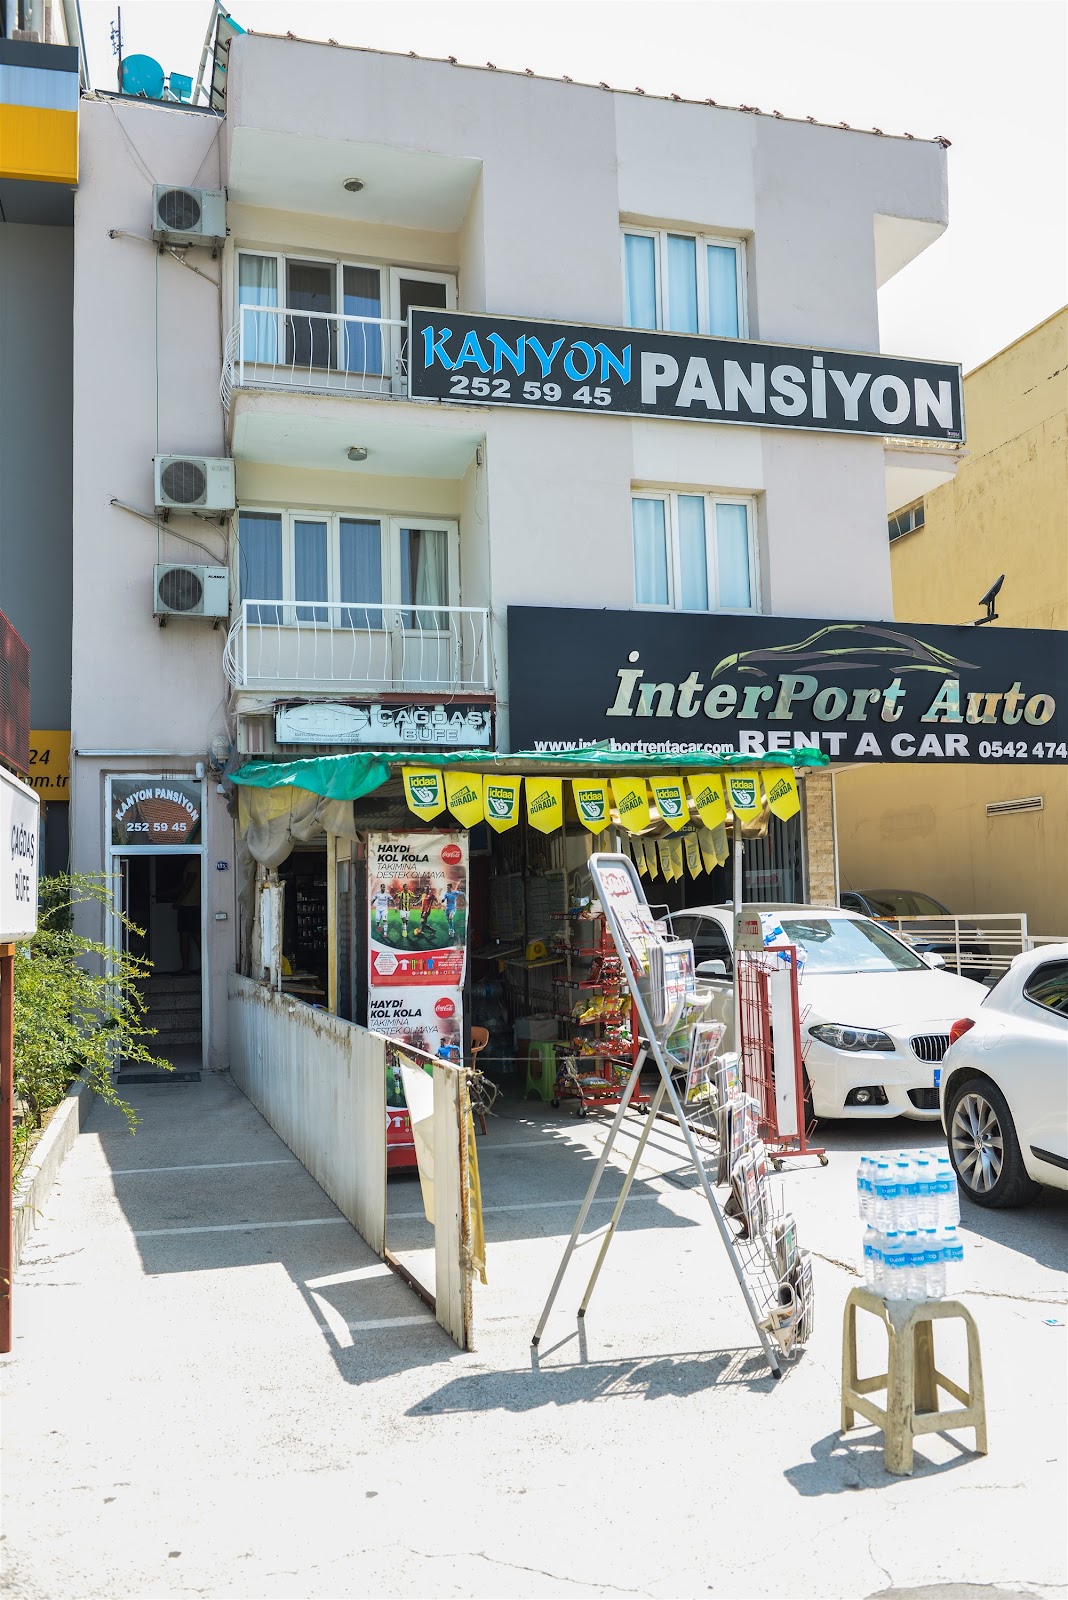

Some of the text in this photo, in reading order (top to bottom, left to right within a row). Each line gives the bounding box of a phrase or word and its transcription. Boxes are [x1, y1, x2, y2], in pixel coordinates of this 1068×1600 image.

[421, 326, 631, 385] KANYON
[450, 375, 612, 406] 252 59 45
[640, 352, 953, 429] PANSİYON
[920, 679, 1056, 725] Auto
[376, 706, 483, 729] ÇAĞDAŞ
[403, 726, 459, 742] BÜFE
[739, 730, 970, 757] RENT A CAR
[978, 741, 1067, 758] 0542 474
[411, 777, 436, 787] iddaa
[732, 780, 753, 789] iddaa
[450, 791, 477, 807] BURADA
[489, 787, 513, 800] iddaa
[580, 792, 602, 801] iddaa
[657, 788, 679, 799] iddaa
[696, 791, 719, 809] BURADA
[769, 782, 793, 803] BURADA
[115, 788, 152, 821] KANYON
[530, 796, 557, 814] BURADA
[619, 796, 643, 814] BURADA
[127, 822, 187, 831] 252 59 45
[11, 823, 35, 866] ÇAĞDAŞ
[377, 854, 429, 862] KOL KOLA
[376, 871, 445, 879] DESTEK OLMAYA
[15, 868, 30, 902] BÜFE
[370, 1000, 403, 1008] HAYDİ
[370, 1009, 422, 1018] KOL KOLA
